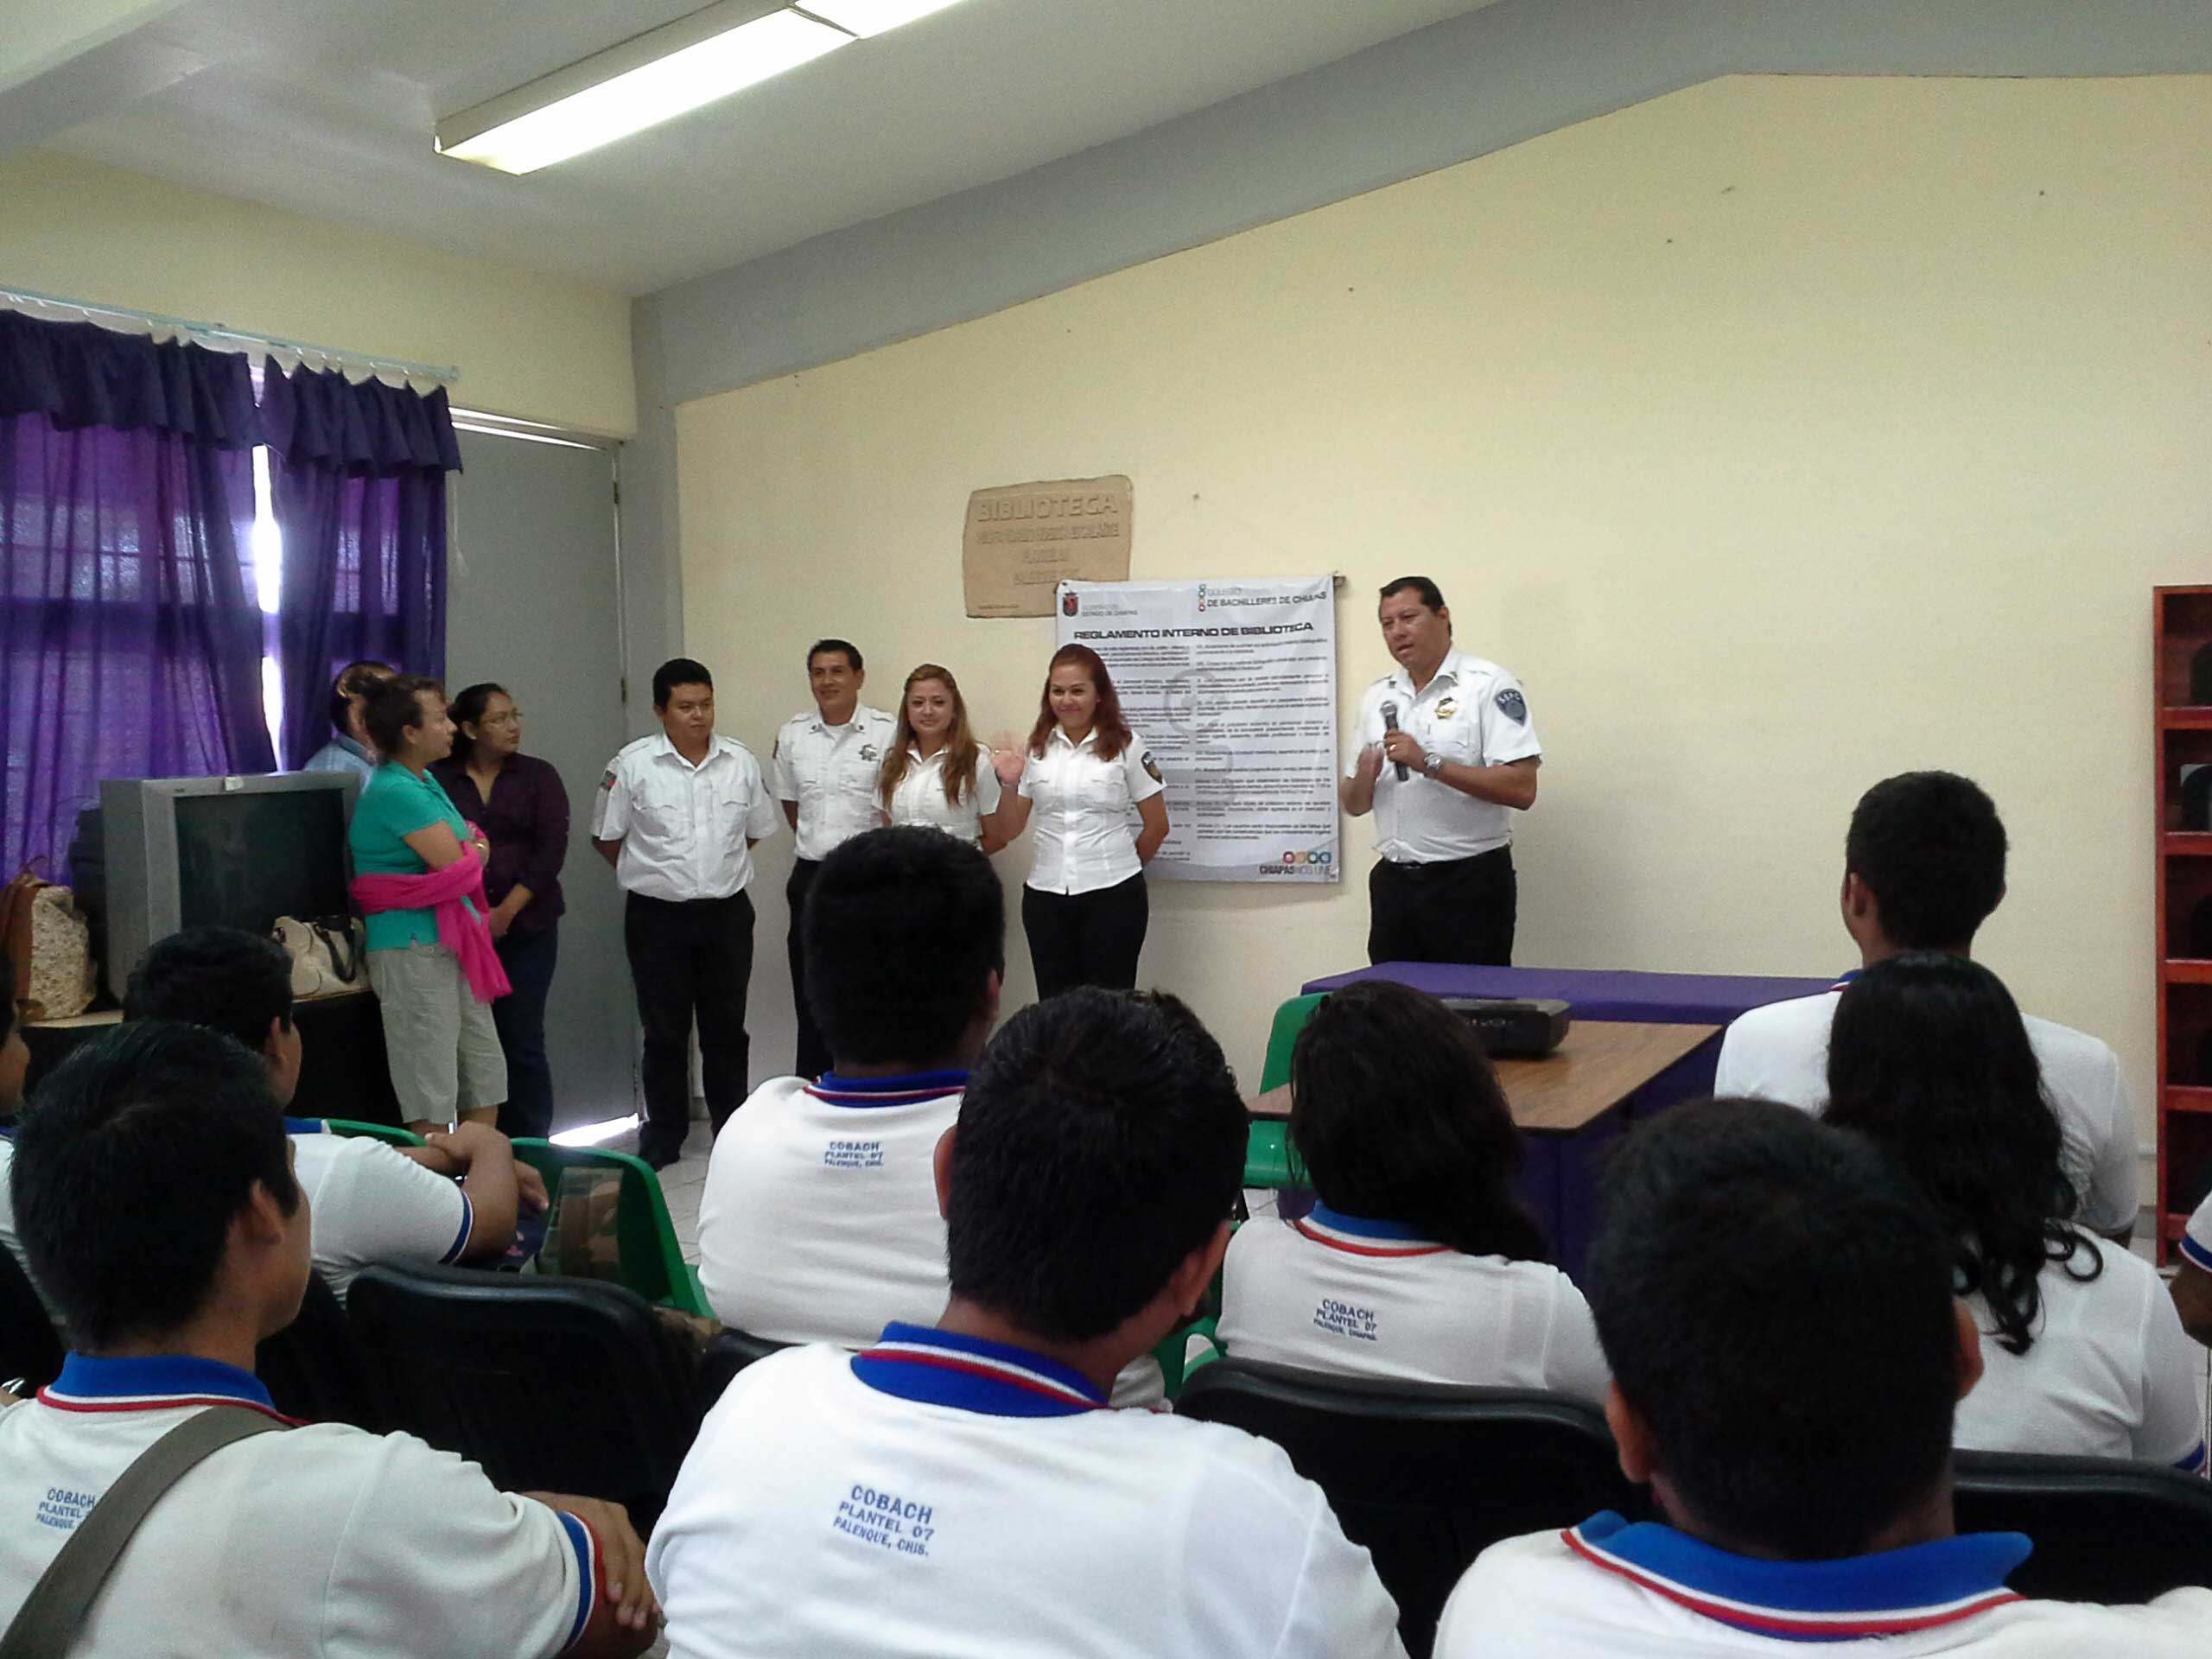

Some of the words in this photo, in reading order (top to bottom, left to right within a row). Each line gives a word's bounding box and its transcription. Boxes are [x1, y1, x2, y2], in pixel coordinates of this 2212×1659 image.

[977, 493, 1119, 522] BIBLIOTECA
[1074, 629, 1160, 639] REGLAMENTO
[1161, 627, 1219, 638] INTERNO
[1221, 627, 1239, 636] DE
[1241, 622, 1313, 635] BIBLIOTECA
[824, 1151, 865, 1160] PLANTEL
[829, 1141, 880, 1152] COBACH
[1316, 1307, 1358, 1329] PLANTEL
[1364, 1321, 1377, 1332] 07
[1322, 1299, 1374, 1322] COBACH
[47, 1487, 96, 1508] COBACH
[851, 1484, 933, 1525] COBACH
[39, 1502, 83, 1518] PLANTEL
[839, 1501, 901, 1534] PLANTEL
[912, 1525, 935, 1541] 07
[833, 1516, 893, 1549] PALENQUE,
[897, 1538, 930, 1556] CHIS.
